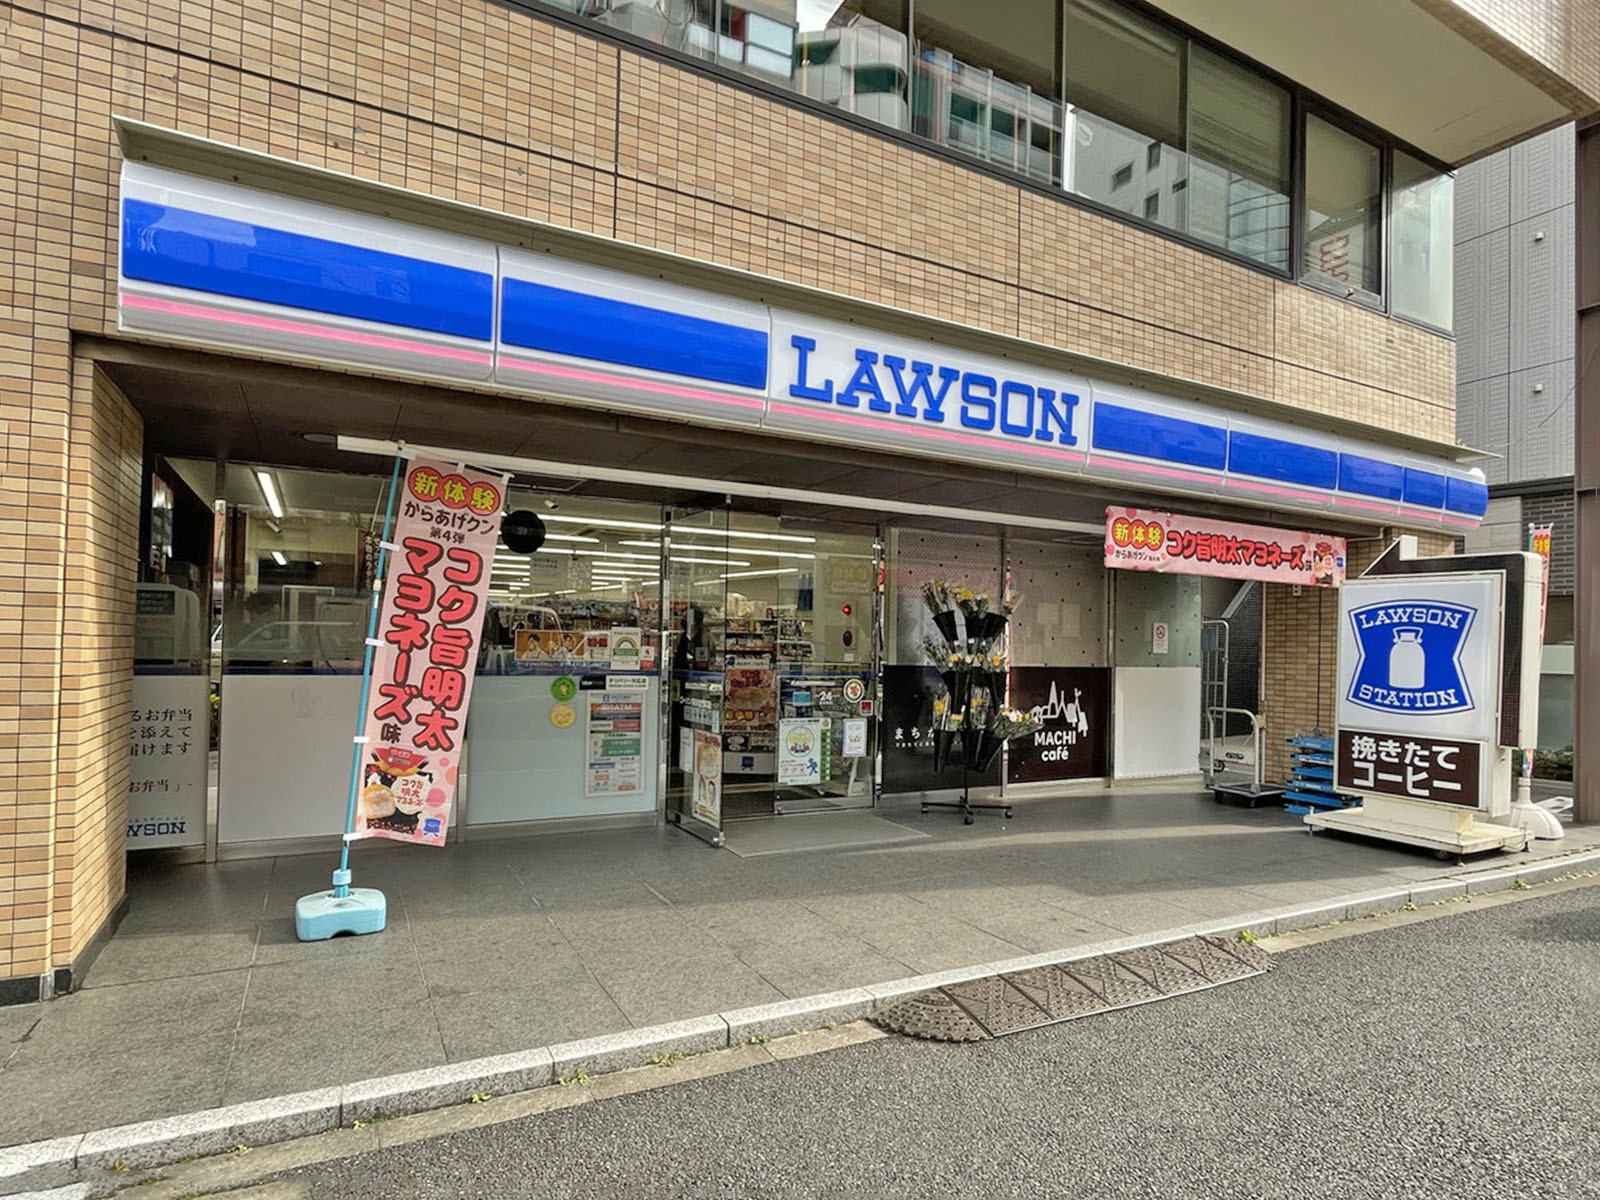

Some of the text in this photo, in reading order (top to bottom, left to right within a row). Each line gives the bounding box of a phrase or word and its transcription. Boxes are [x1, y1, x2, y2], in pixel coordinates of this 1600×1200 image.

[789, 335, 1080, 445] LAWSON
[414, 472, 496, 512] 新体験
[404, 501, 494, 535] からあげクン
[430, 526, 465, 545] 第4弾
[1114, 522, 1161, 546] 新体験
[1359, 608, 1463, 630] LAWSON
[412, 547, 484, 751] コク旨明太
[1358, 684, 1459, 708] STATION
[1034, 730, 1077, 747] MACHI
[1351, 735, 1460, 770] 挽きたて
[1041, 746, 1069, 762] café
[1352, 762, 1462, 797] コーヒー
